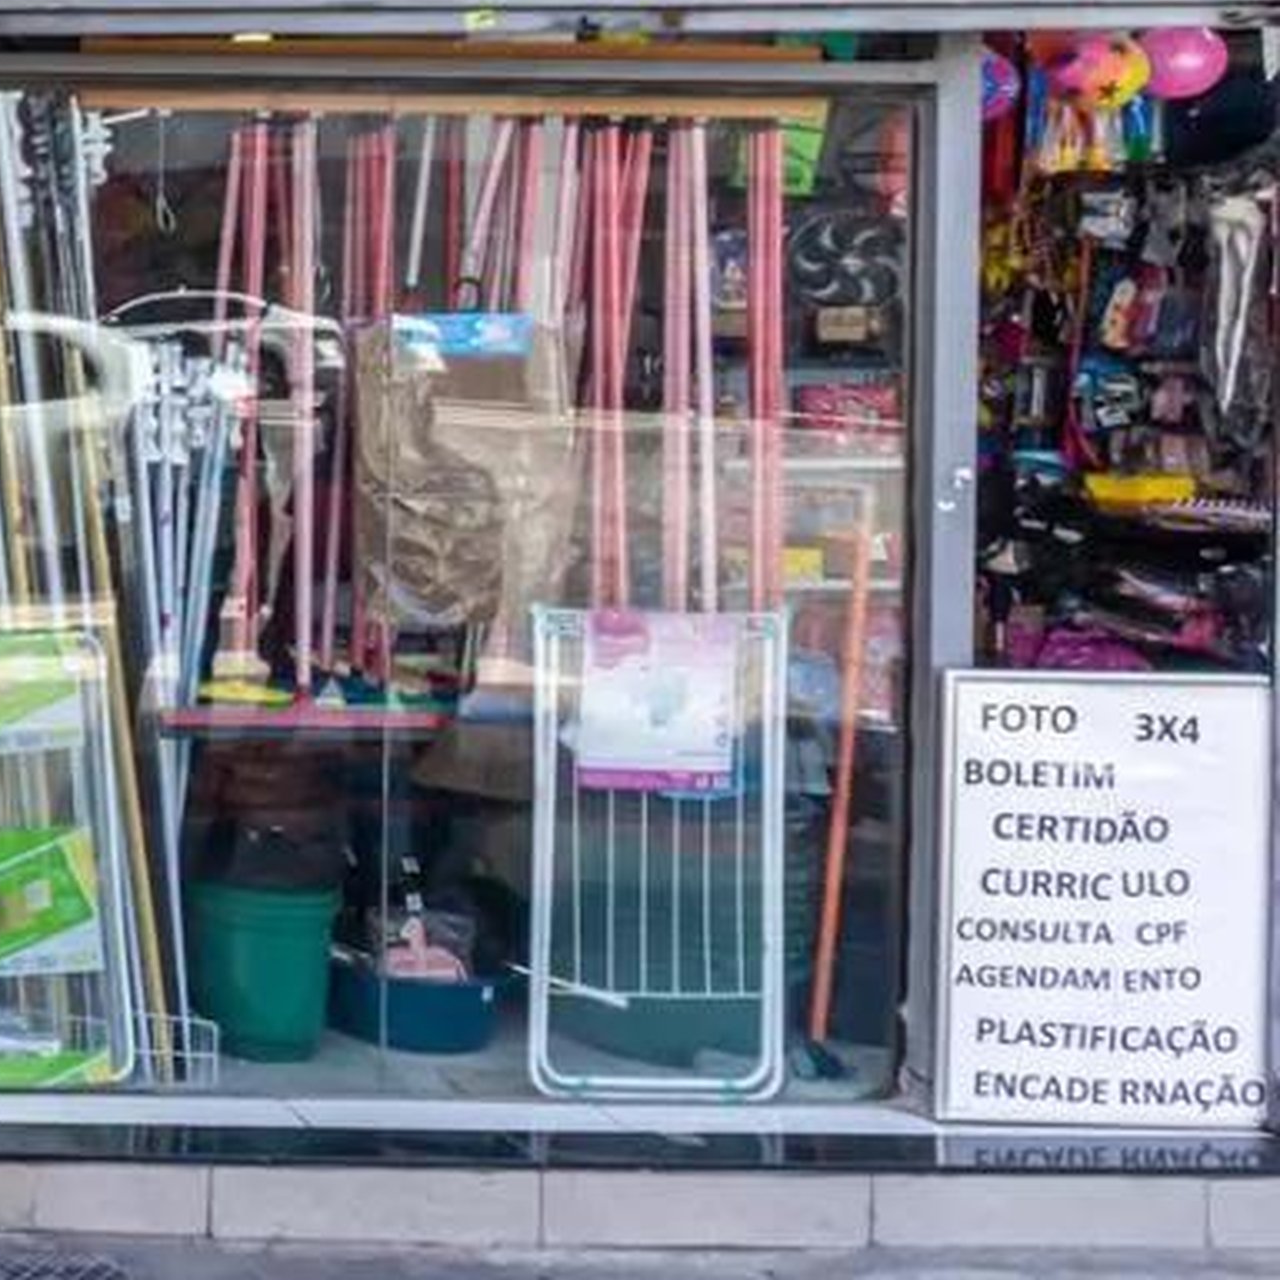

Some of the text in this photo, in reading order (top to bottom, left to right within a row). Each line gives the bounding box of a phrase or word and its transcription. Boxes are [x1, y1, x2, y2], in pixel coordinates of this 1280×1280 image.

[980, 702, 1201, 745] FOTO 3X4
[963, 758, 1117, 790] BOLETIM
[992, 810, 1170, 844] CERTIDÃO
[956, 918, 1189, 946] CONSULTA CPF
[975, 1018, 1240, 1060] PLASTIFICAÇÃO
